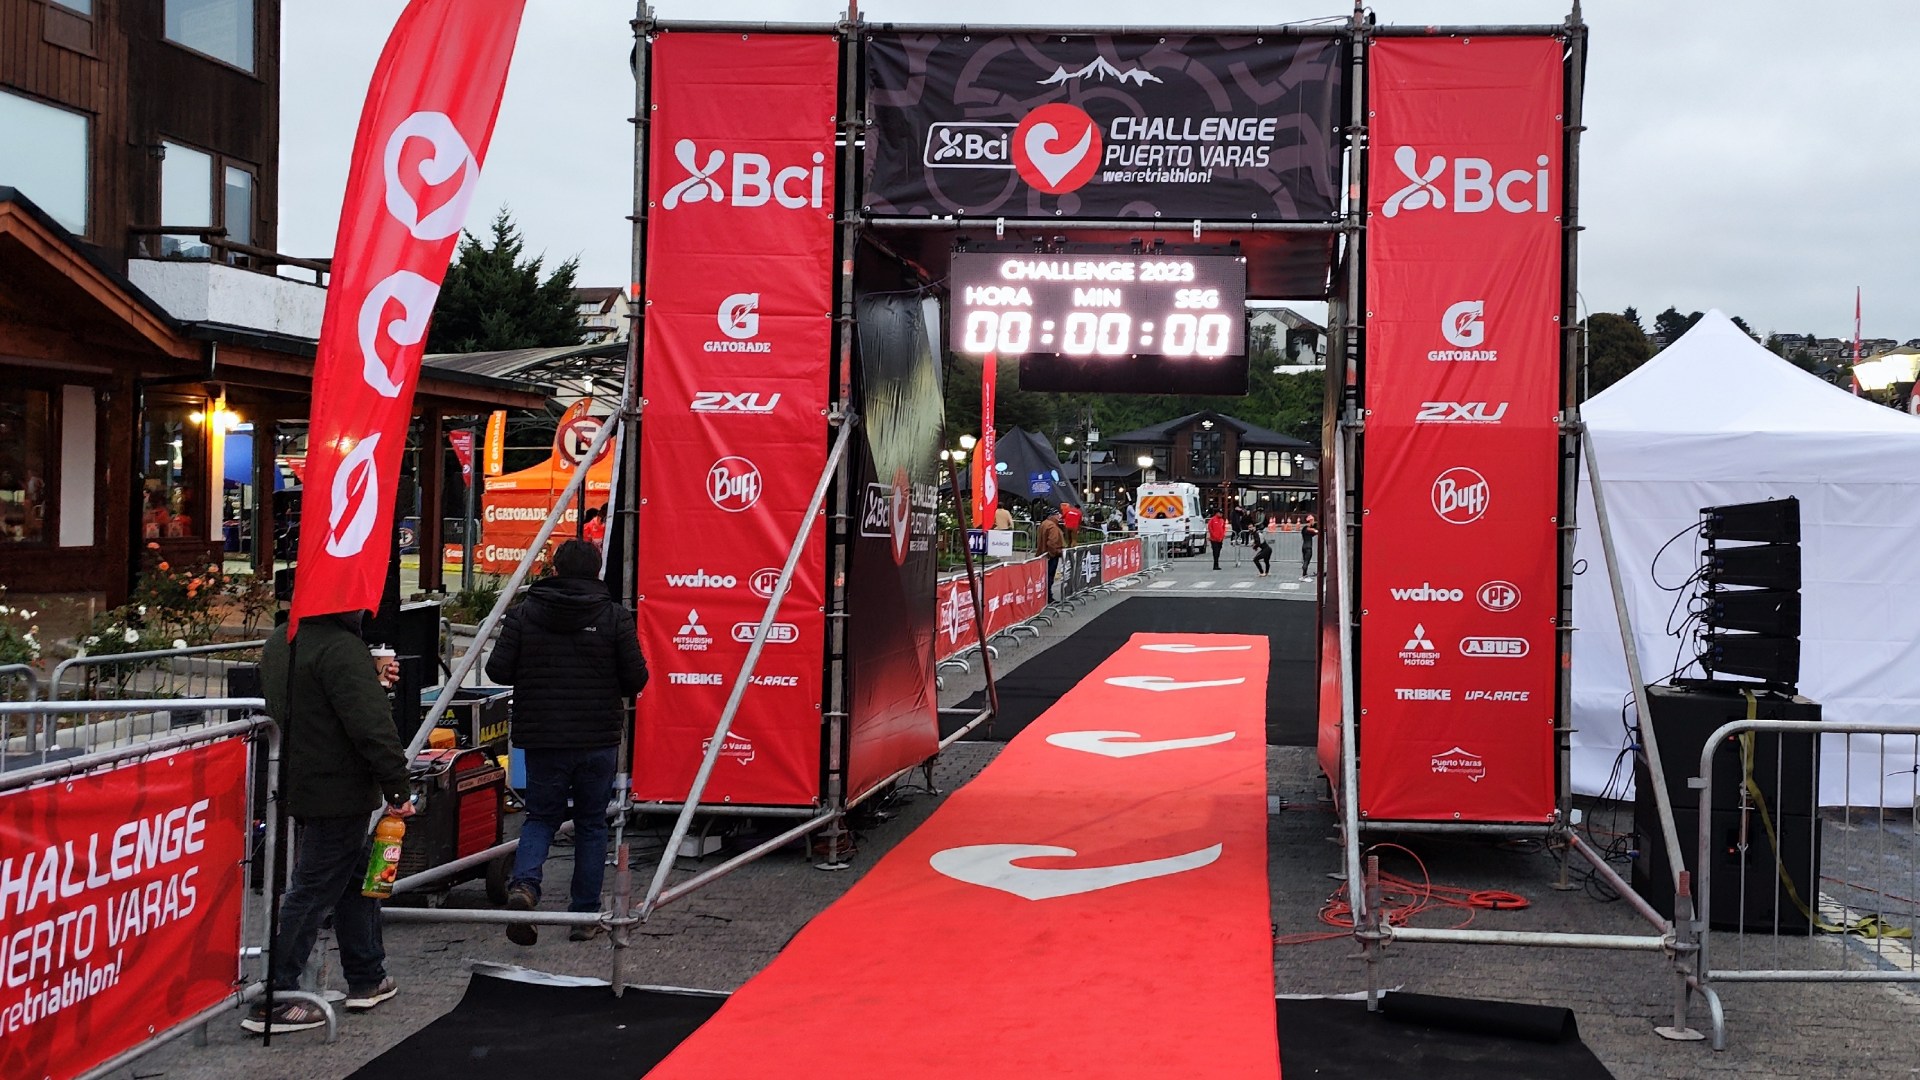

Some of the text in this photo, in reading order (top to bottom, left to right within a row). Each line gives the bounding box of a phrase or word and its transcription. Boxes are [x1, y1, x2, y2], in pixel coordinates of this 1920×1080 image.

[1110, 117, 1277, 141] CHALLENGE
[965, 133, 1007, 160] Bci
[1105, 145, 1270, 167] PUERTO VARAS
[732, 152, 825, 209] Bci
[1103, 168, 1212, 183] wearetriathlon!
[1454, 154, 1549, 213] Bci
[1001, 260, 1194, 282] CHALLENGE 2023
[965, 286, 1219, 309] HORA MIN SEG
[703, 341, 771, 353] GATORADE
[1427, 350, 1498, 362] GATORADE
[691, 391, 781, 411] 2XU
[1416, 402, 1509, 421] 2XU
[713, 467, 758, 503] Buff
[1437, 478, 1486, 514] Buff
[496, 507, 548, 521] GATORADE
[666, 568, 737, 589] wahoo
[1390, 582, 1510, 605] wahoo PF
[672, 637, 713, 645] MITSUBISHI
[678, 643, 708, 651] MOTORS
[1466, 640, 1521, 654] ABUS
[1398, 651, 1441, 659] MITSUBISHI
[1404, 658, 1435, 666] MOTORS
[668, 673, 723, 685] TRIBIKE
[1394, 688, 1530, 702] TRIBIKE UP4RACE
[1431, 759, 1482, 767] Puerto Varas
[0, 798, 210, 921] HALLENGE
[107, 865, 199, 949] VARAS
